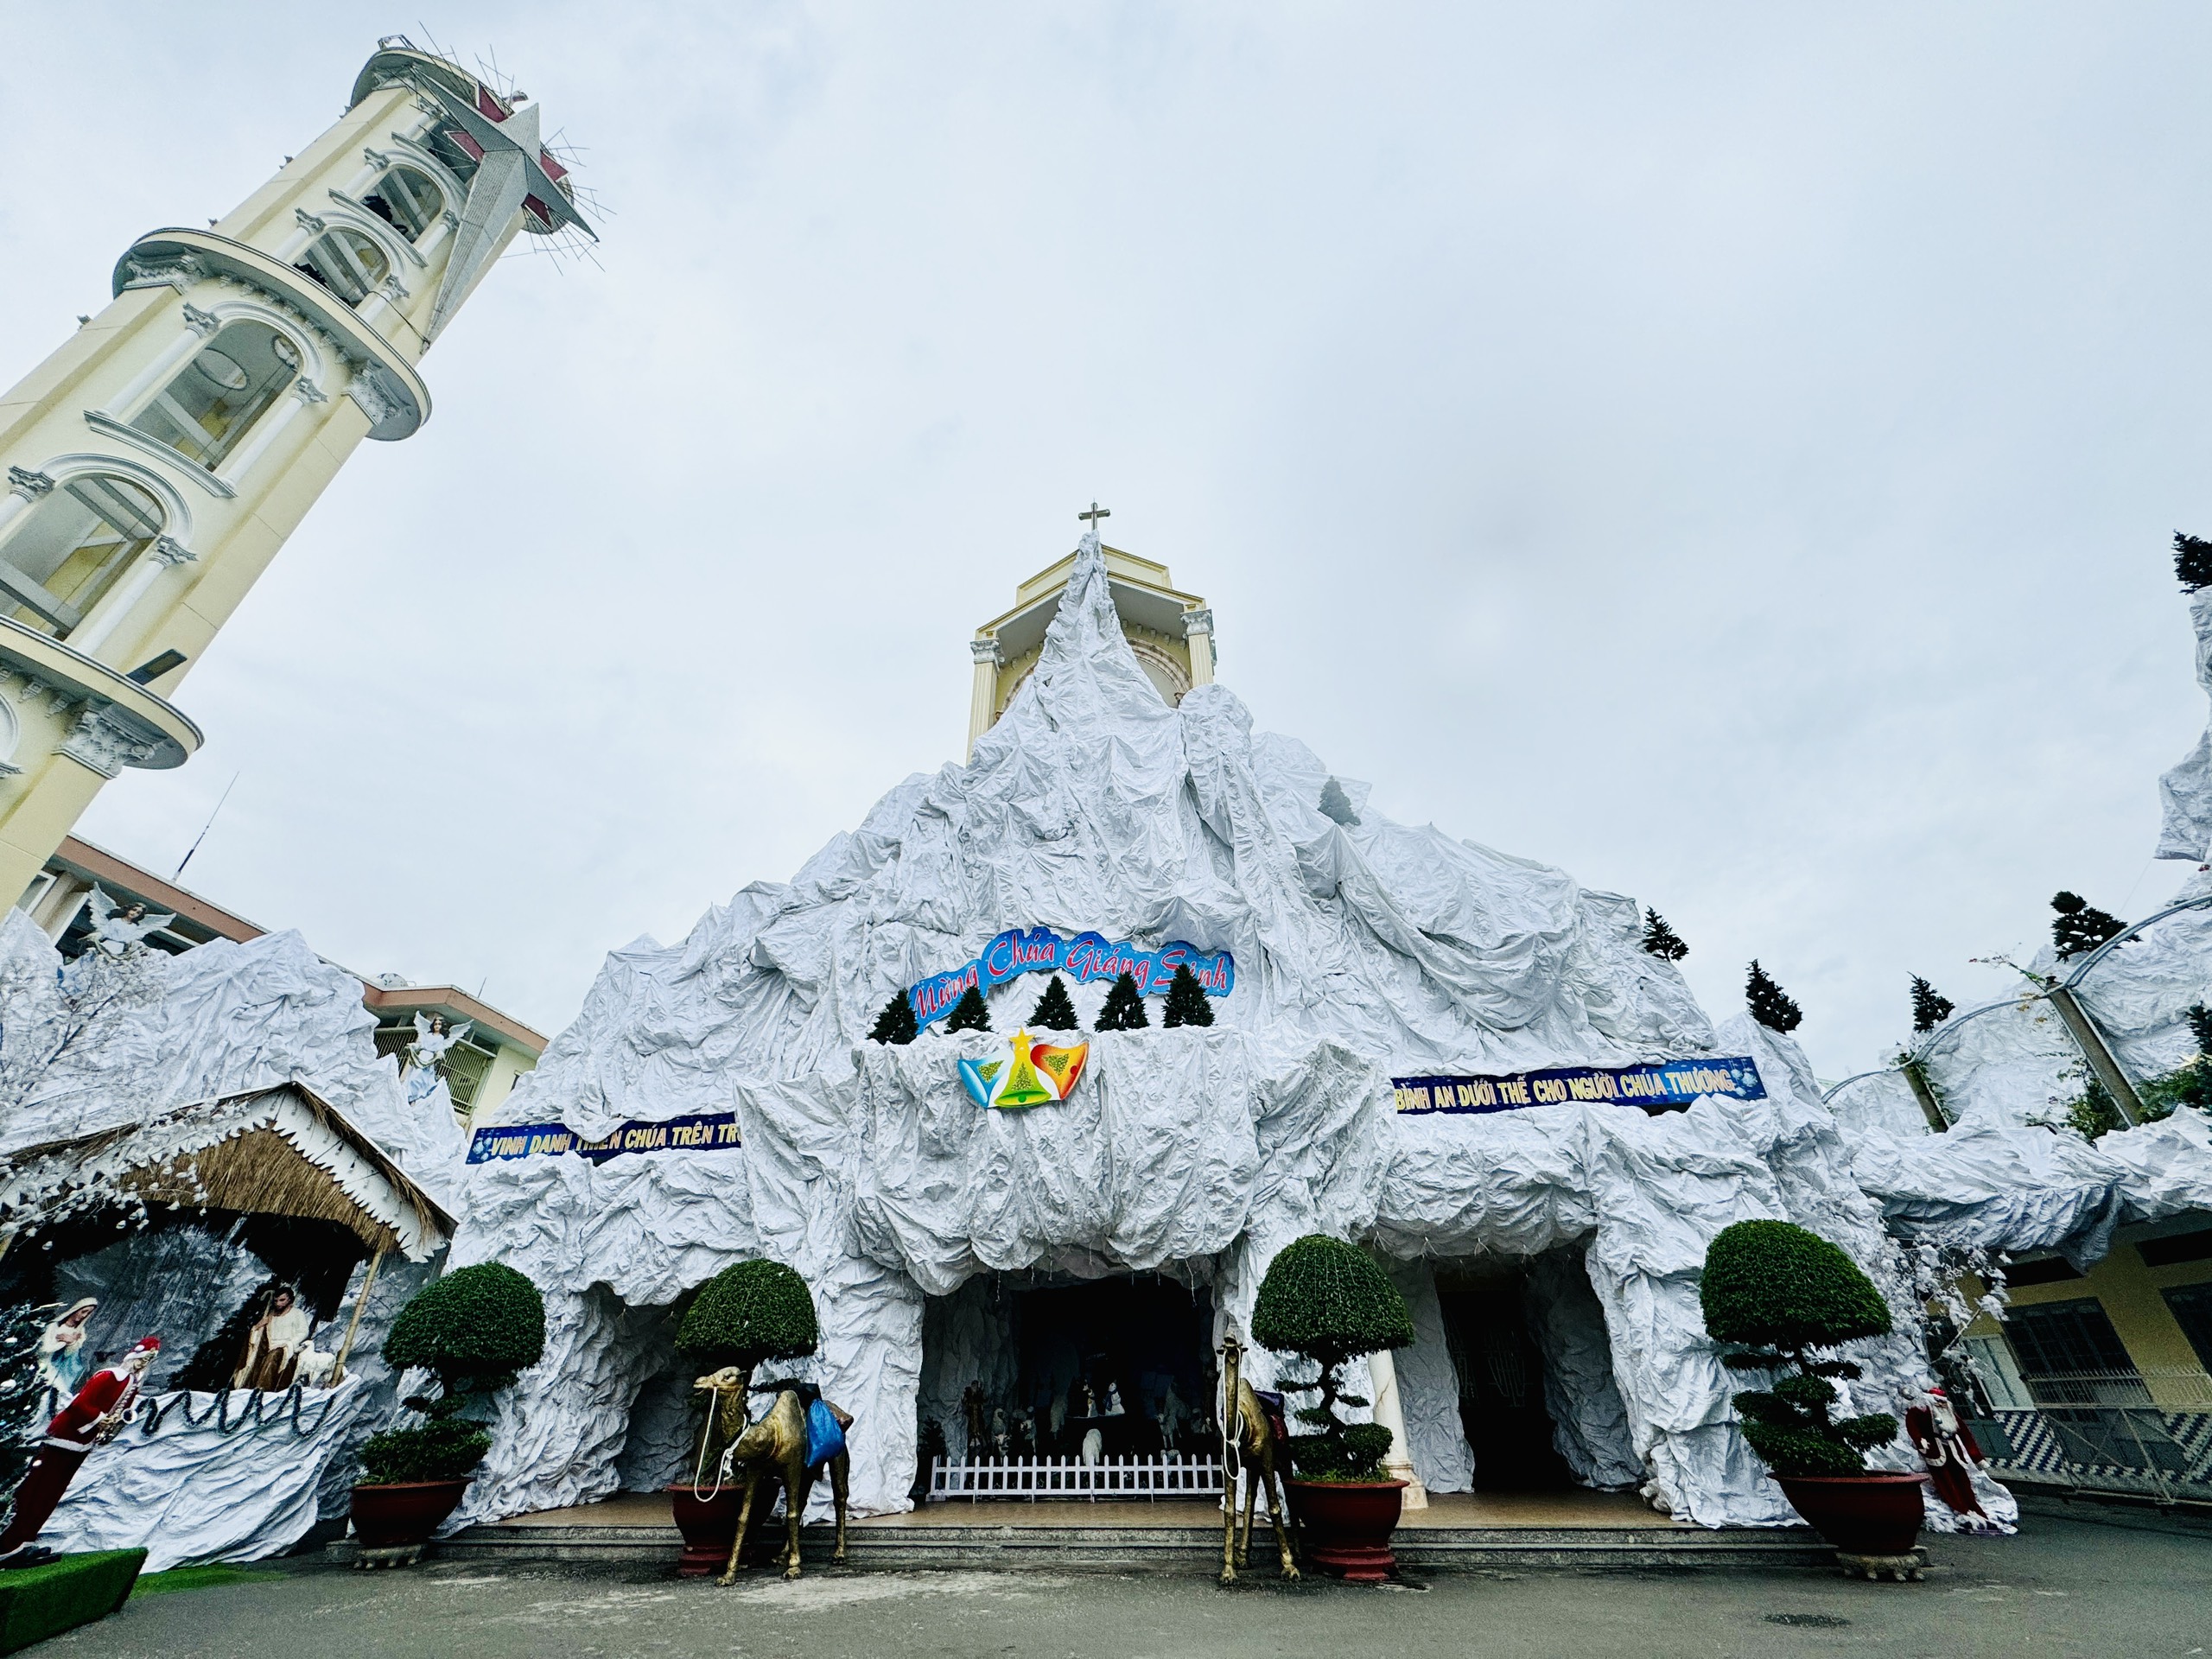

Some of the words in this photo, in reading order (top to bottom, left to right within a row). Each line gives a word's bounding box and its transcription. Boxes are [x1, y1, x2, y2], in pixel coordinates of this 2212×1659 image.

[988, 932, 1055, 976] Chúa
[1066, 939, 1150, 989] Giáng
[1395, 1083, 1432, 1111] BÌNH
[1434, 1085, 1456, 1109] AN
[1457, 1077, 1497, 1107] DƯỚI
[1497, 1074, 1531, 1104] THẾ
[1533, 1078, 1567, 1103] CHO
[1567, 1071, 1621, 1100] NGƯỜI
[1620, 1068, 1668, 1097] CHÚA
[1665, 1066, 1736, 1095] THƯƠNG
[491, 1135, 528, 1156] VINH
[529, 1133, 573, 1154] DANH
[625, 1124, 666, 1148] CHÚA
[671, 1121, 714, 1146] TRÊN
[718, 1123, 742, 1143] TR
